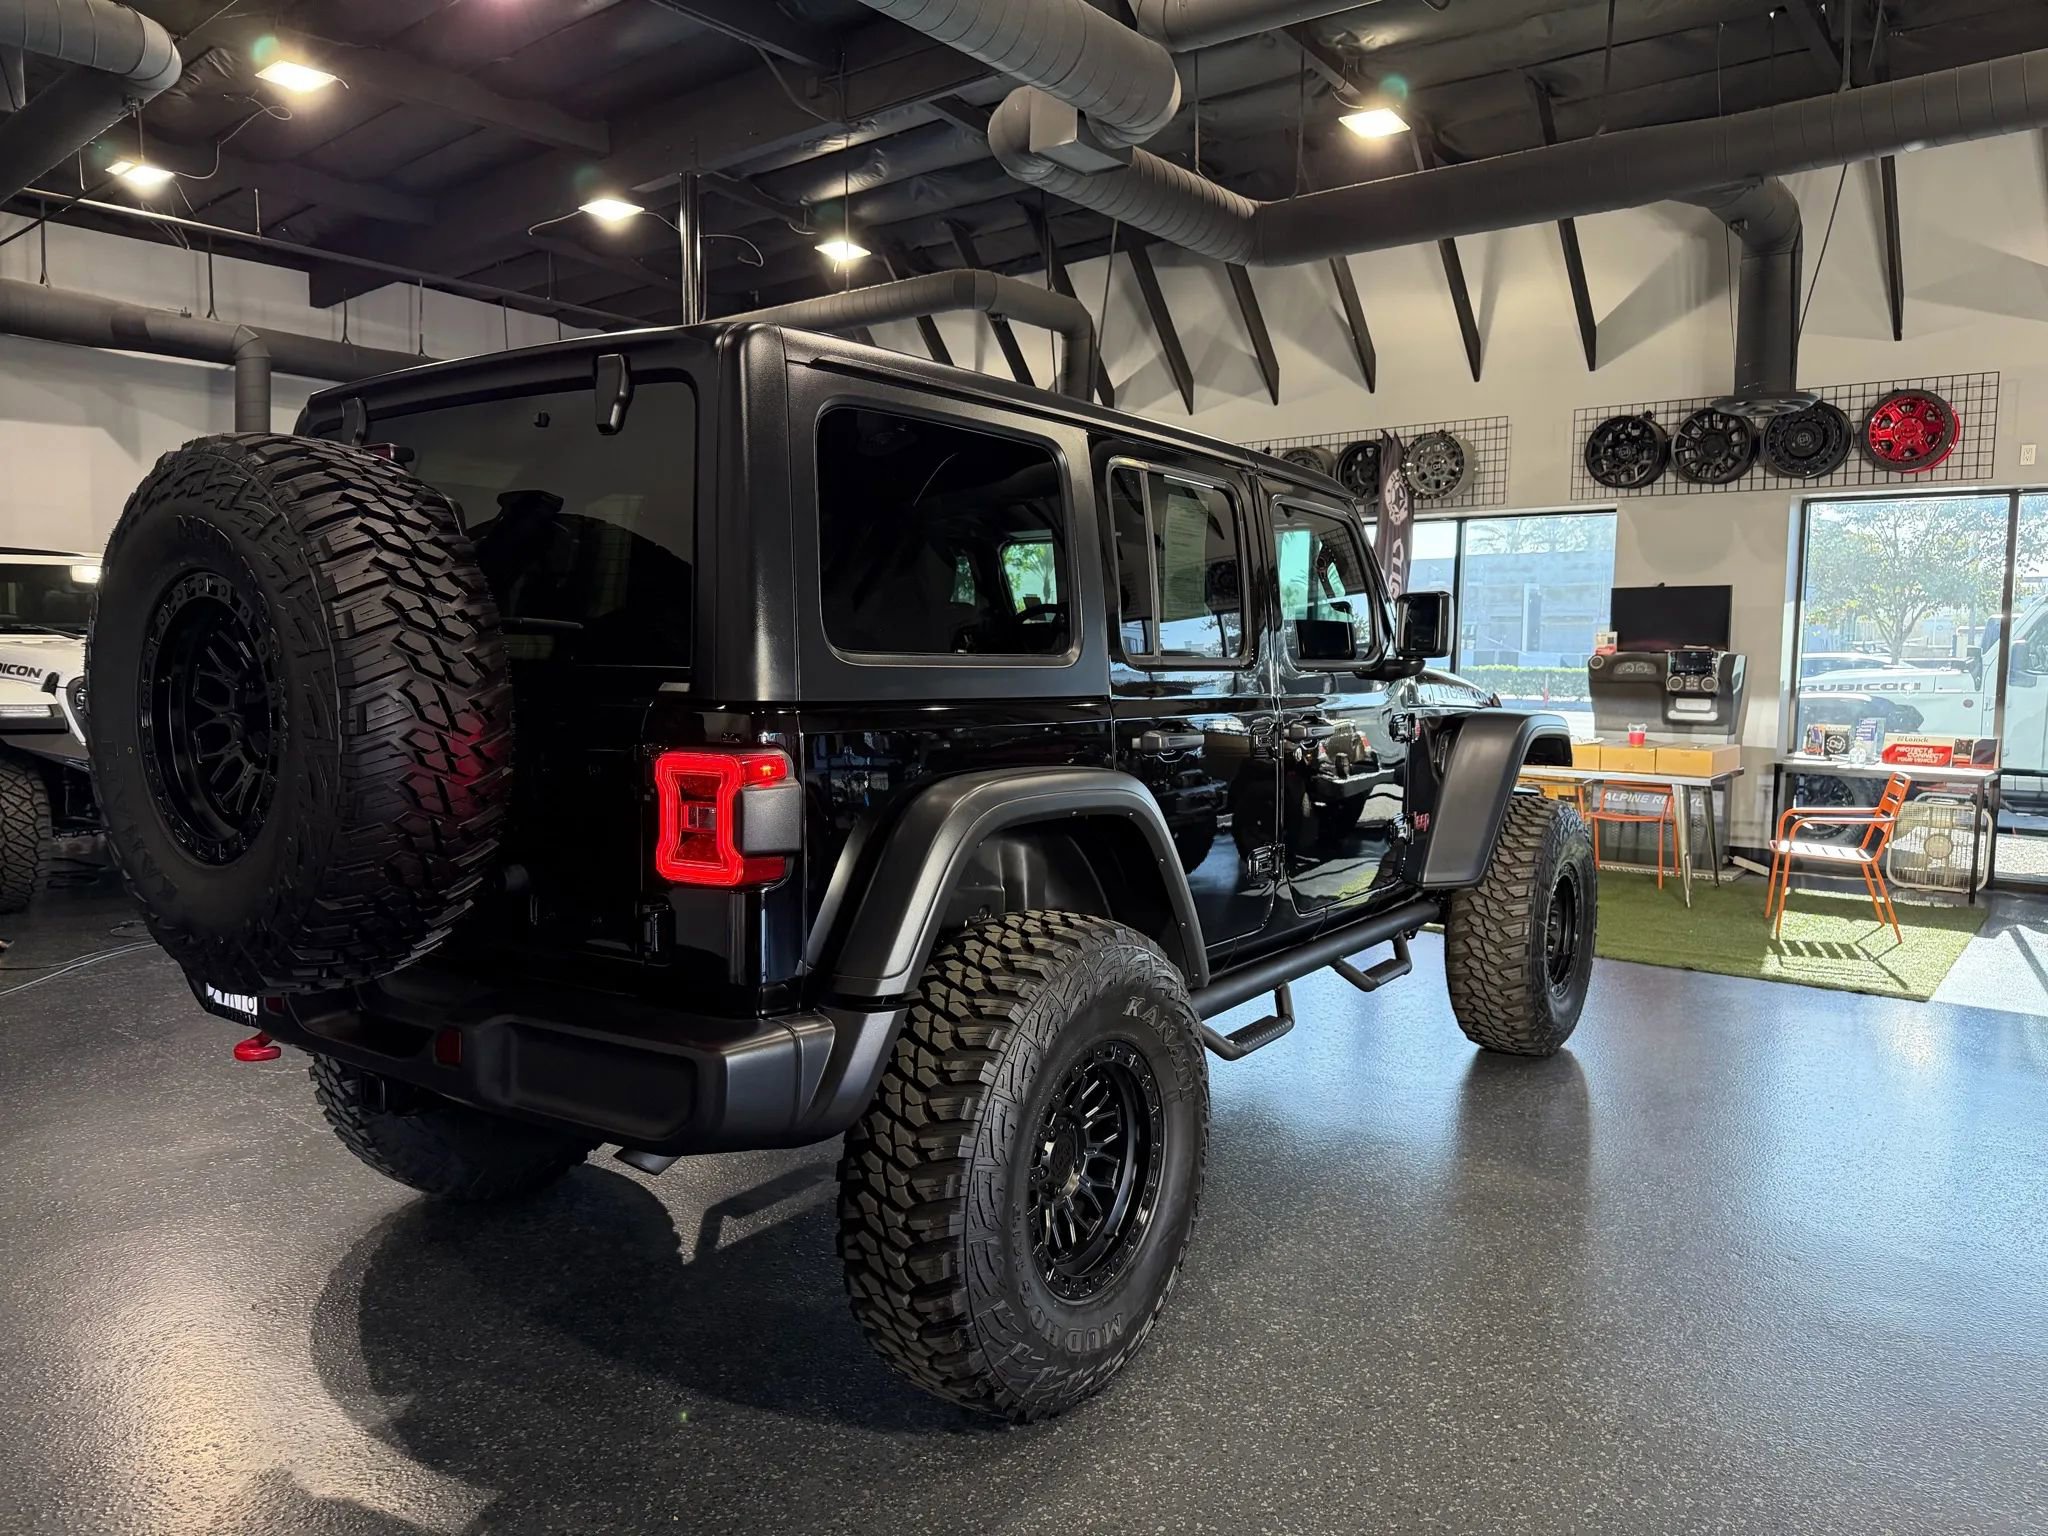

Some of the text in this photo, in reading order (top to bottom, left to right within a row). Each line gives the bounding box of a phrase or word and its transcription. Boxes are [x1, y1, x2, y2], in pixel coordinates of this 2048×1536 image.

[0, 662, 43, 678] ICON
[1895, 746, 1927, 754] PROTECT
[1907, 752, 1944, 760] CONNECT
[1604, 791, 1649, 804] ALPINE
[1122, 995, 1194, 1103] KANATI
[1064, 1312, 1124, 1354] MUD
